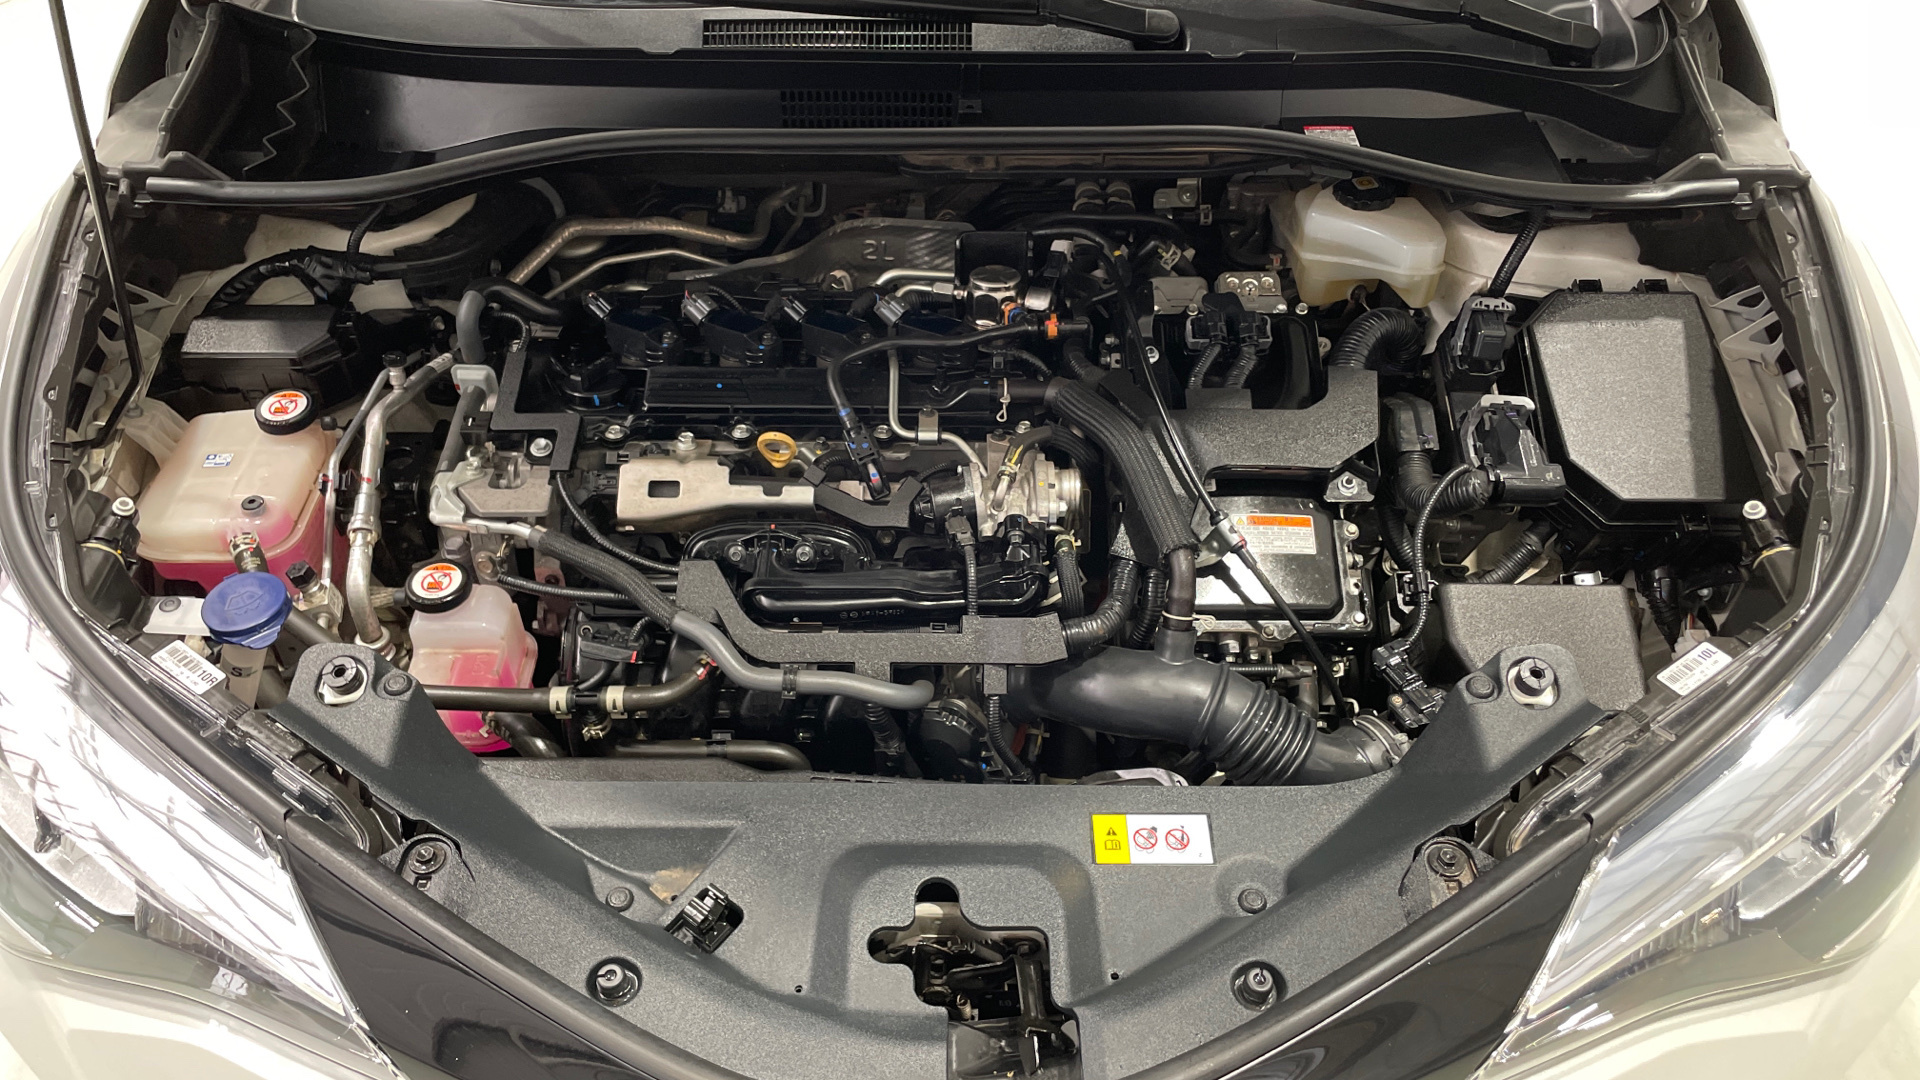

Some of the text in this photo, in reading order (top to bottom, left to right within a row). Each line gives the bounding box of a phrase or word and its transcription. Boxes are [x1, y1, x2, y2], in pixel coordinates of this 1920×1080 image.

[863, 239, 895, 261] 2L
[1697, 648, 1718, 661] 10L
[197, 669, 218, 686] 10R
[231, 667, 243, 677] S
